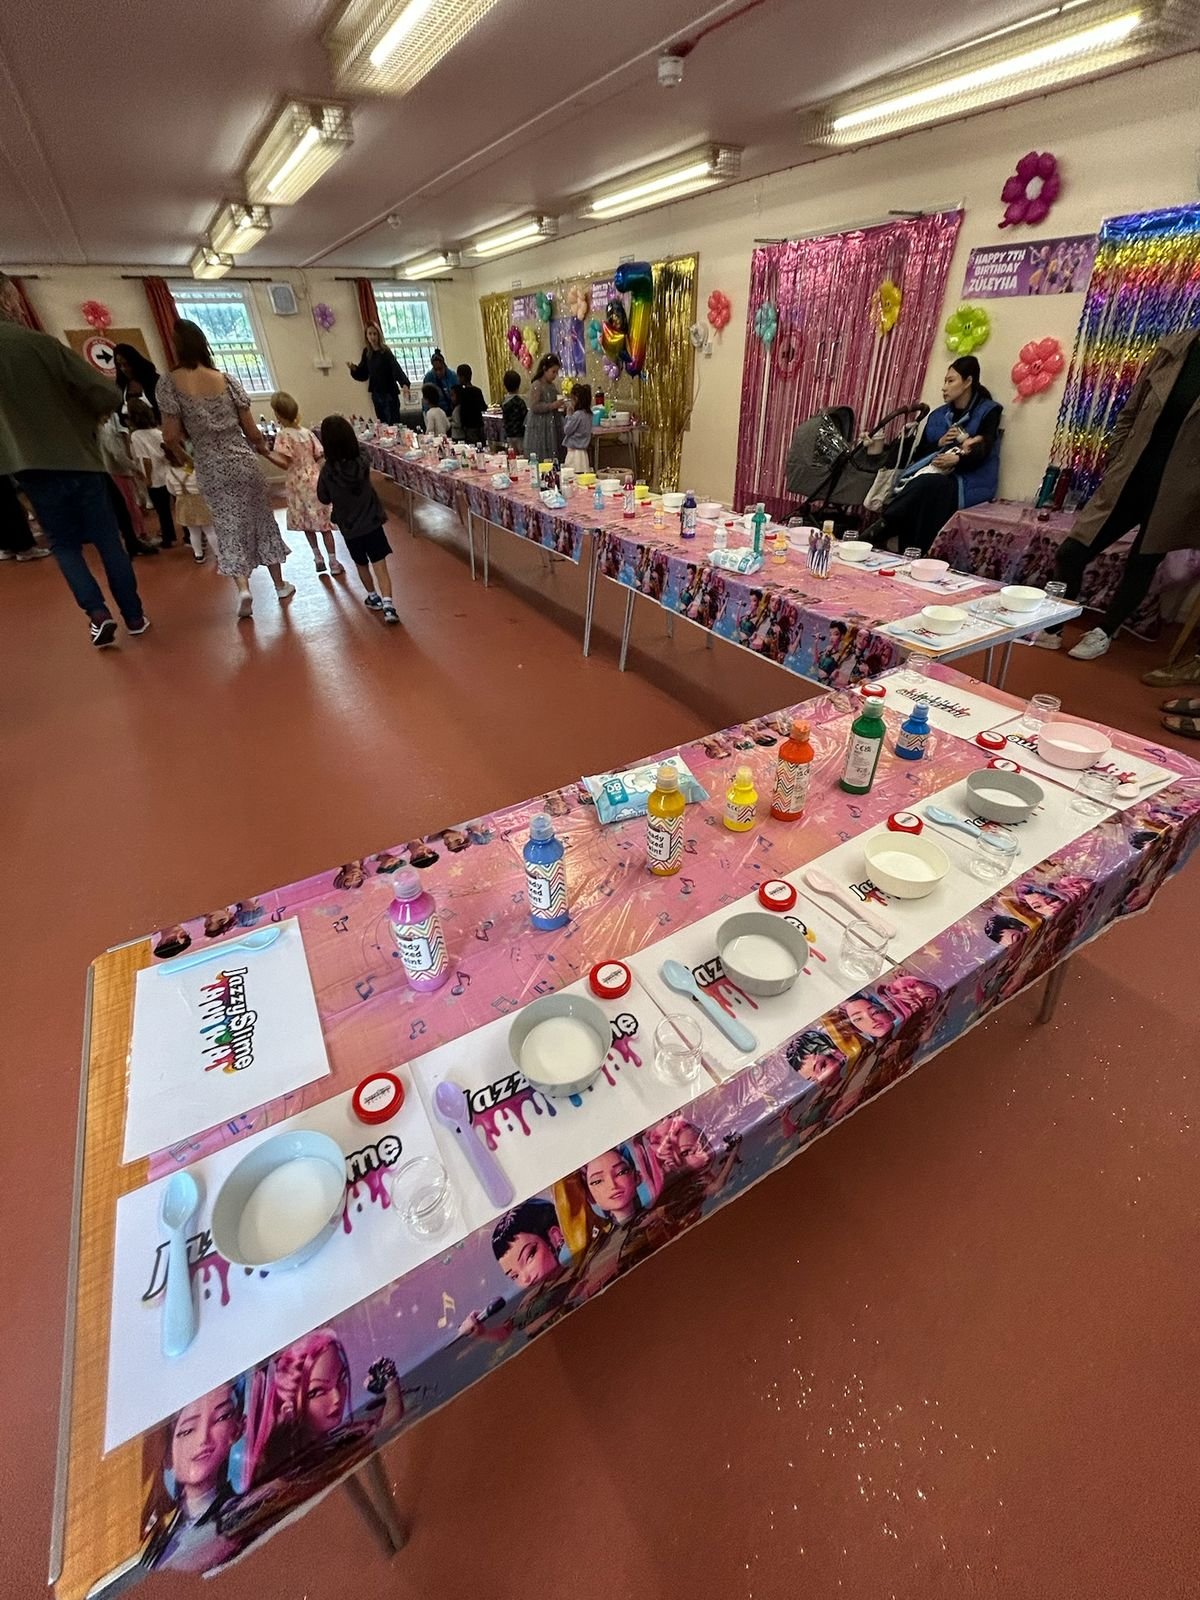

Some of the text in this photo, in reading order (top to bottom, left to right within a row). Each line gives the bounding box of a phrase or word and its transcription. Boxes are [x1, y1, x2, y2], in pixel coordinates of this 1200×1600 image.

[974, 249, 1026, 265] HAPPY 7TH
[974, 262, 1021, 276] BIRTHDAY
[222, 967, 257, 1070] Jazzy Slime
